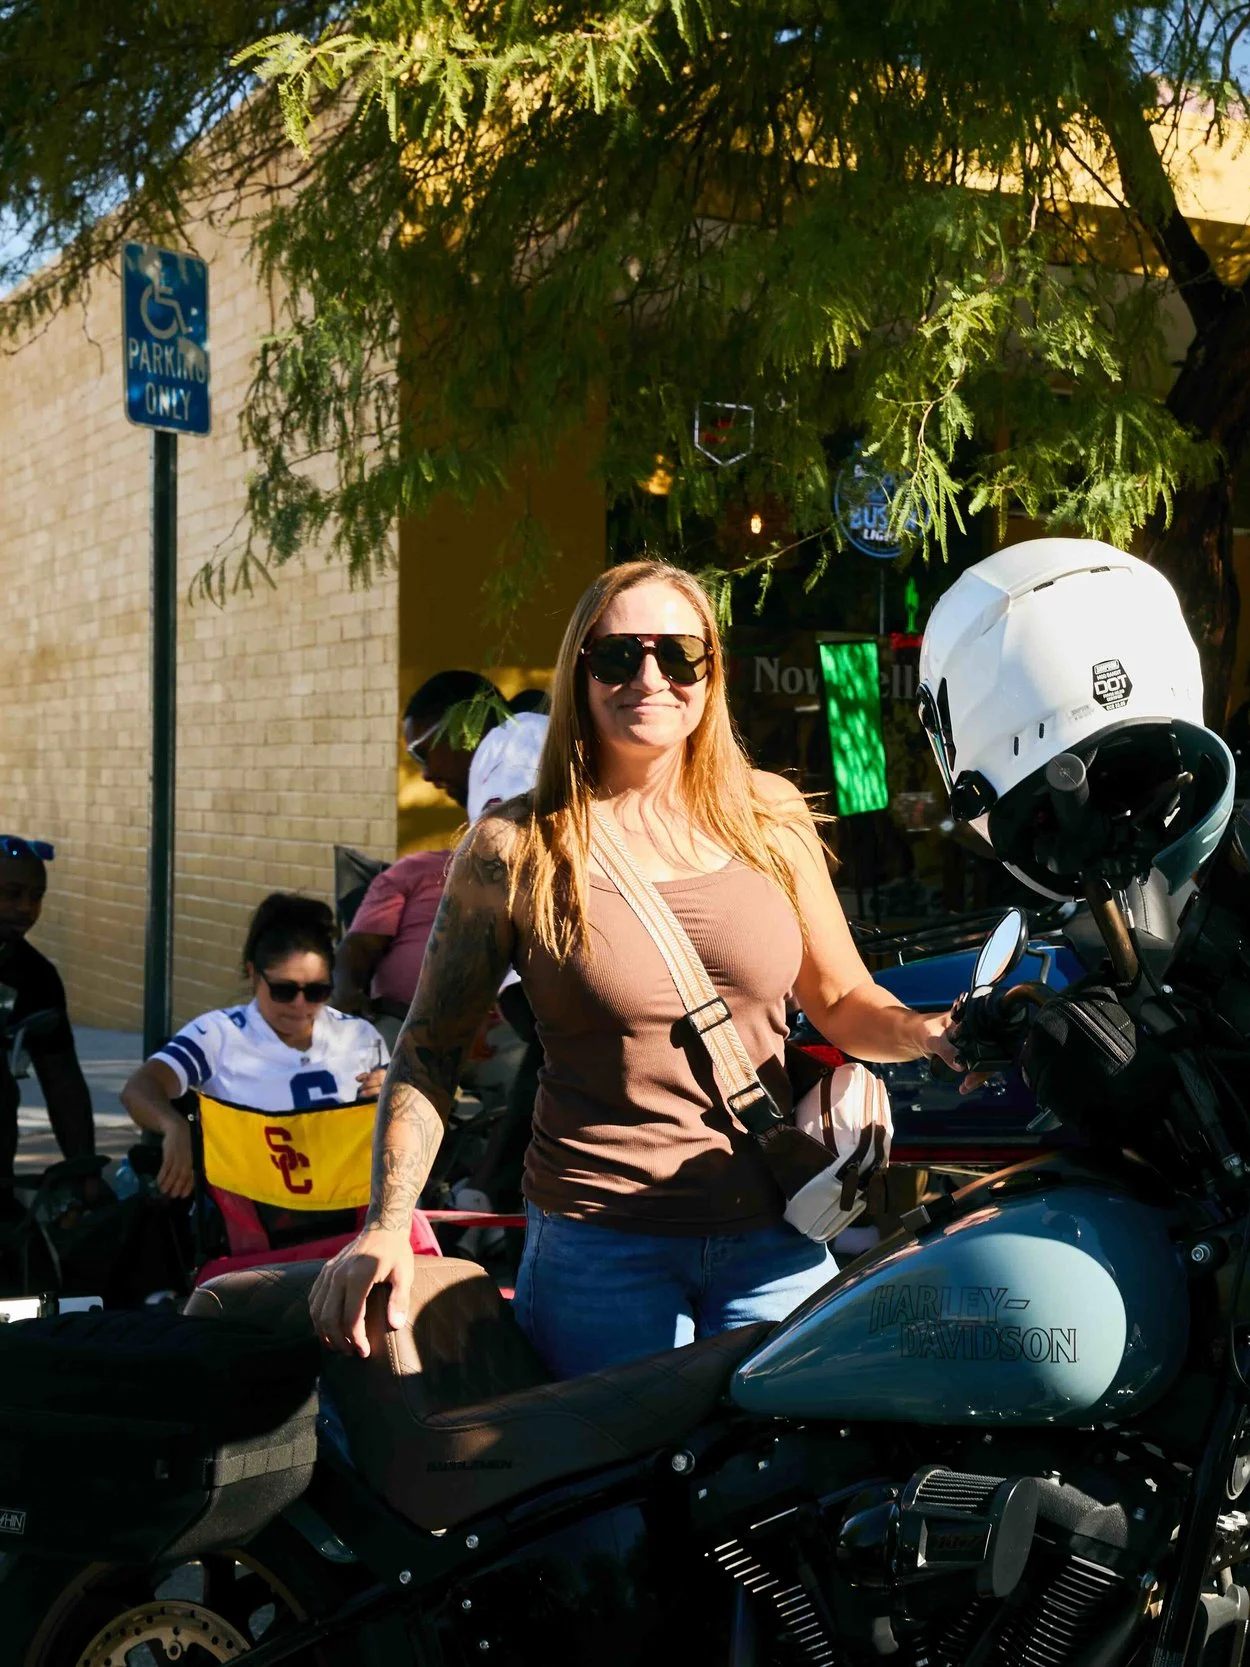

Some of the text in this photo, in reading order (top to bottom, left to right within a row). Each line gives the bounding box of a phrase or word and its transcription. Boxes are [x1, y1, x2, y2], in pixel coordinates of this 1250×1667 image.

[128, 337, 208, 384] PARKING
[145, 381, 192, 421] ONLY
[1094, 674, 1127, 695] DOT
[265, 1126, 313, 1194] SC
[868, 1285, 1031, 1335] HARLEY-
[900, 1322, 1077, 1364] DAVIDSON
